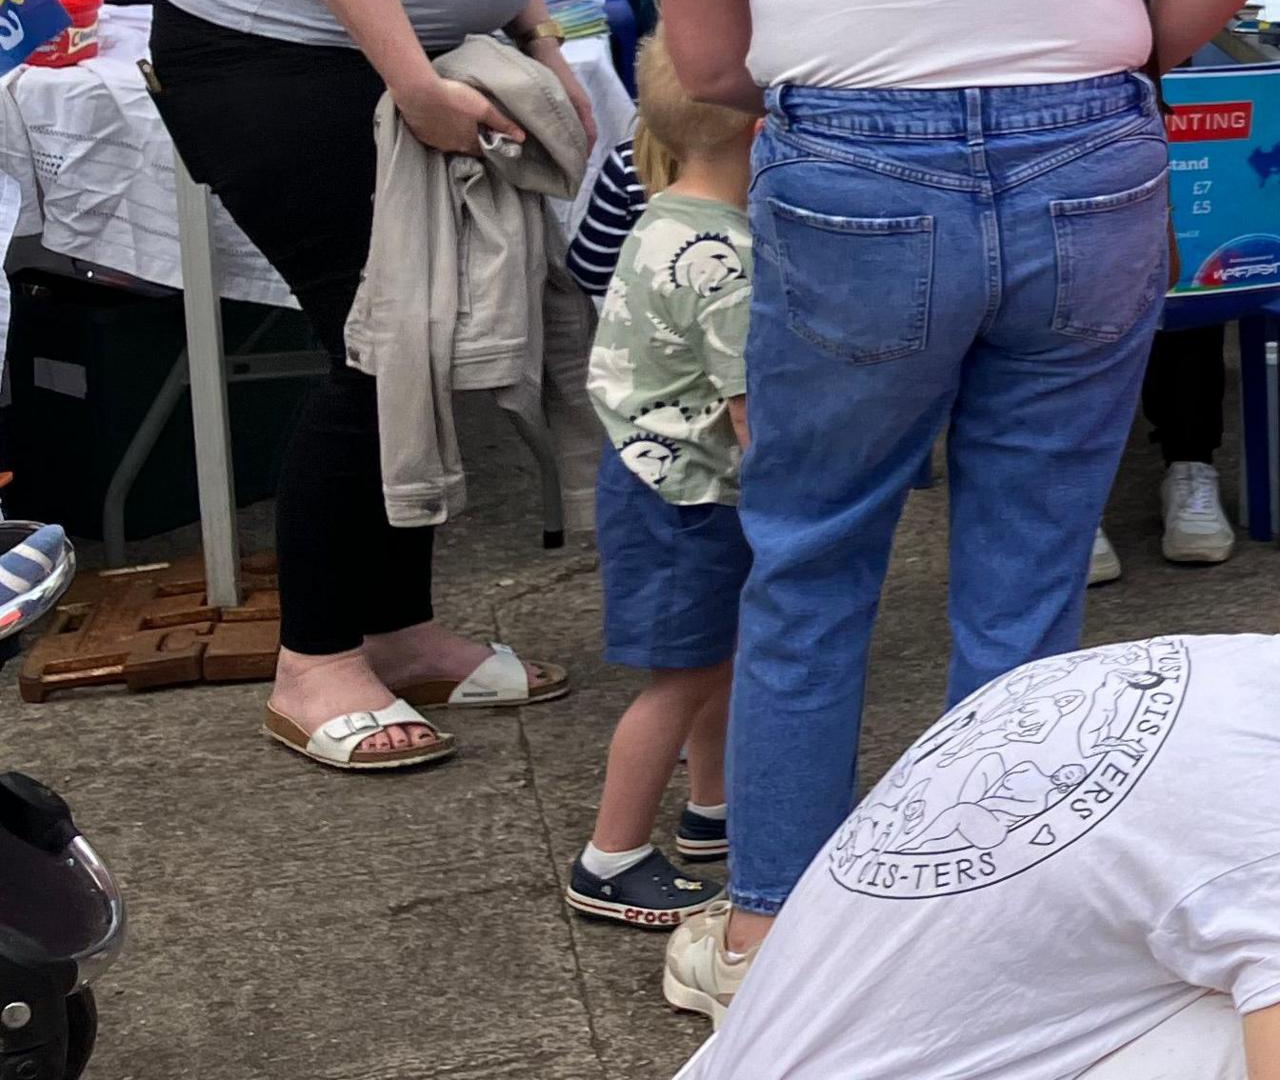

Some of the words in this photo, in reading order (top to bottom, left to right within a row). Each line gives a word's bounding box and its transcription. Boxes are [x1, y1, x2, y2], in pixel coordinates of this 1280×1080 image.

[1193, 180, 1213, 195] £7
[1193, 200, 1212, 214] £5
[624, 907, 681, 923] crocs
